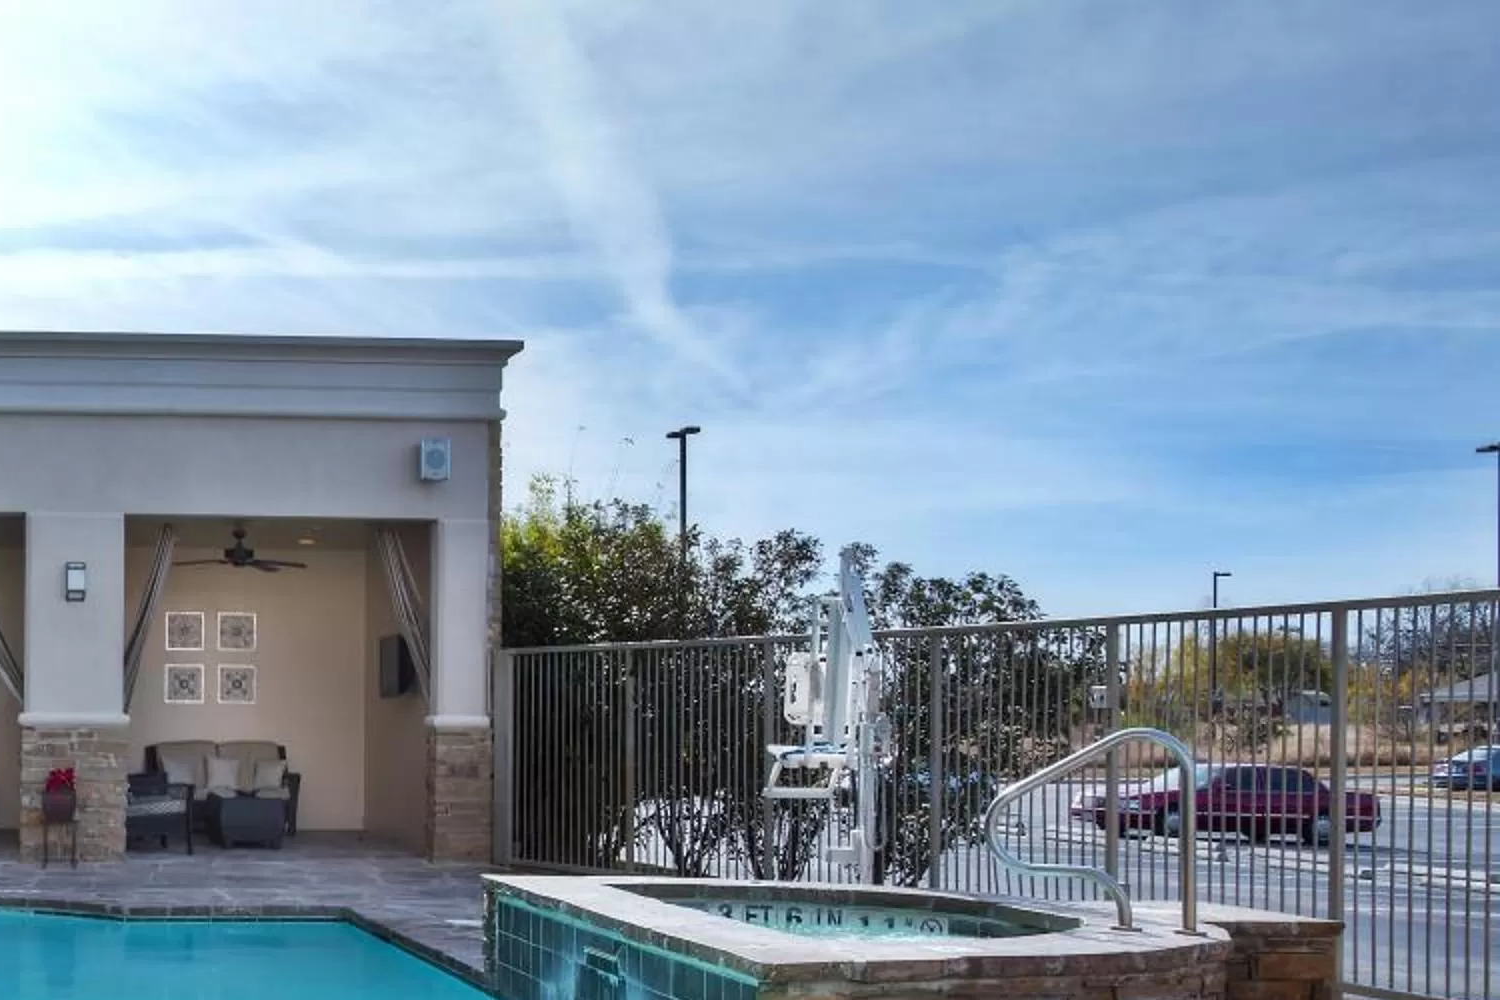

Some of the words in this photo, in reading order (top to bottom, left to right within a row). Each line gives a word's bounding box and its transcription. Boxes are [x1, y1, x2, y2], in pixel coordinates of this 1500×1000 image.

[745, 905, 773, 923] FT
[786, 906, 802, 924] 6
[816, 908, 843, 926] IN
